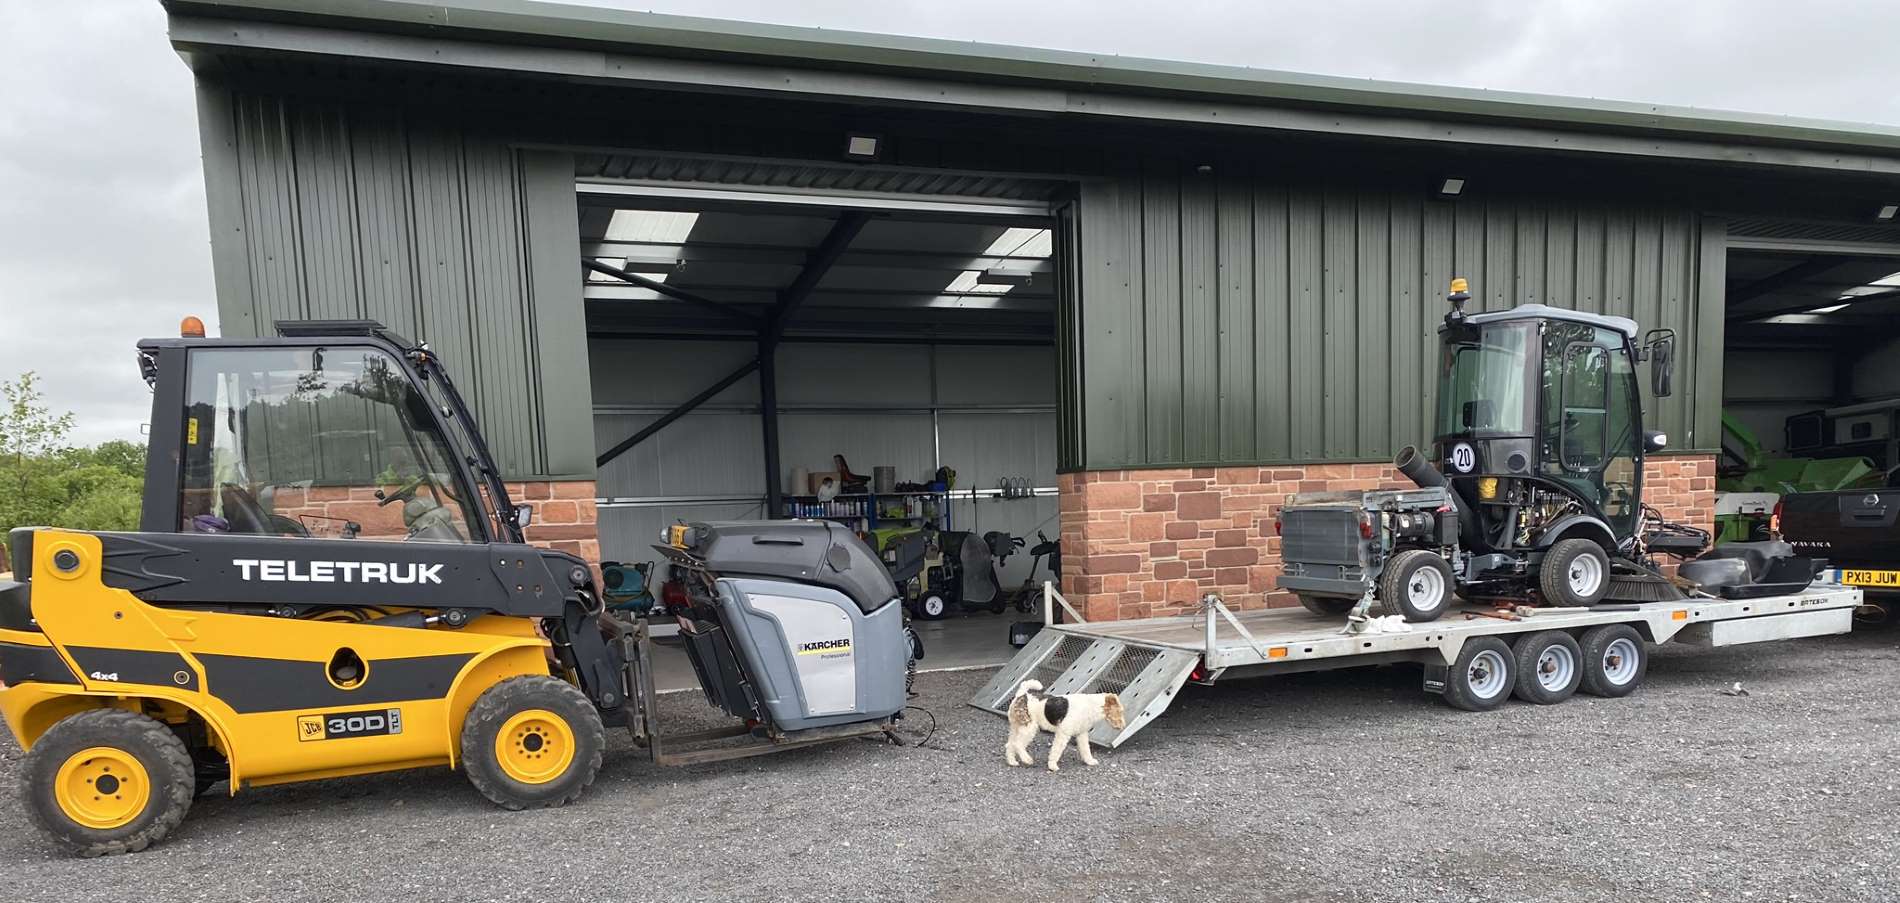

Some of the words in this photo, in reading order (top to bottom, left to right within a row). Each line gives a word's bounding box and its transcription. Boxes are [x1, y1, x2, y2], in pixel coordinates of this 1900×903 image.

[1457, 448, 1471, 467] 20
[232, 558, 444, 584] TELETRUK
[1847, 571, 1872, 584] PX13
[1875, 572, 1898, 585] JUW
[90, 671, 119, 681] 4x4
[304, 721, 322, 735] JCB
[328, 715, 385, 734] 30D
